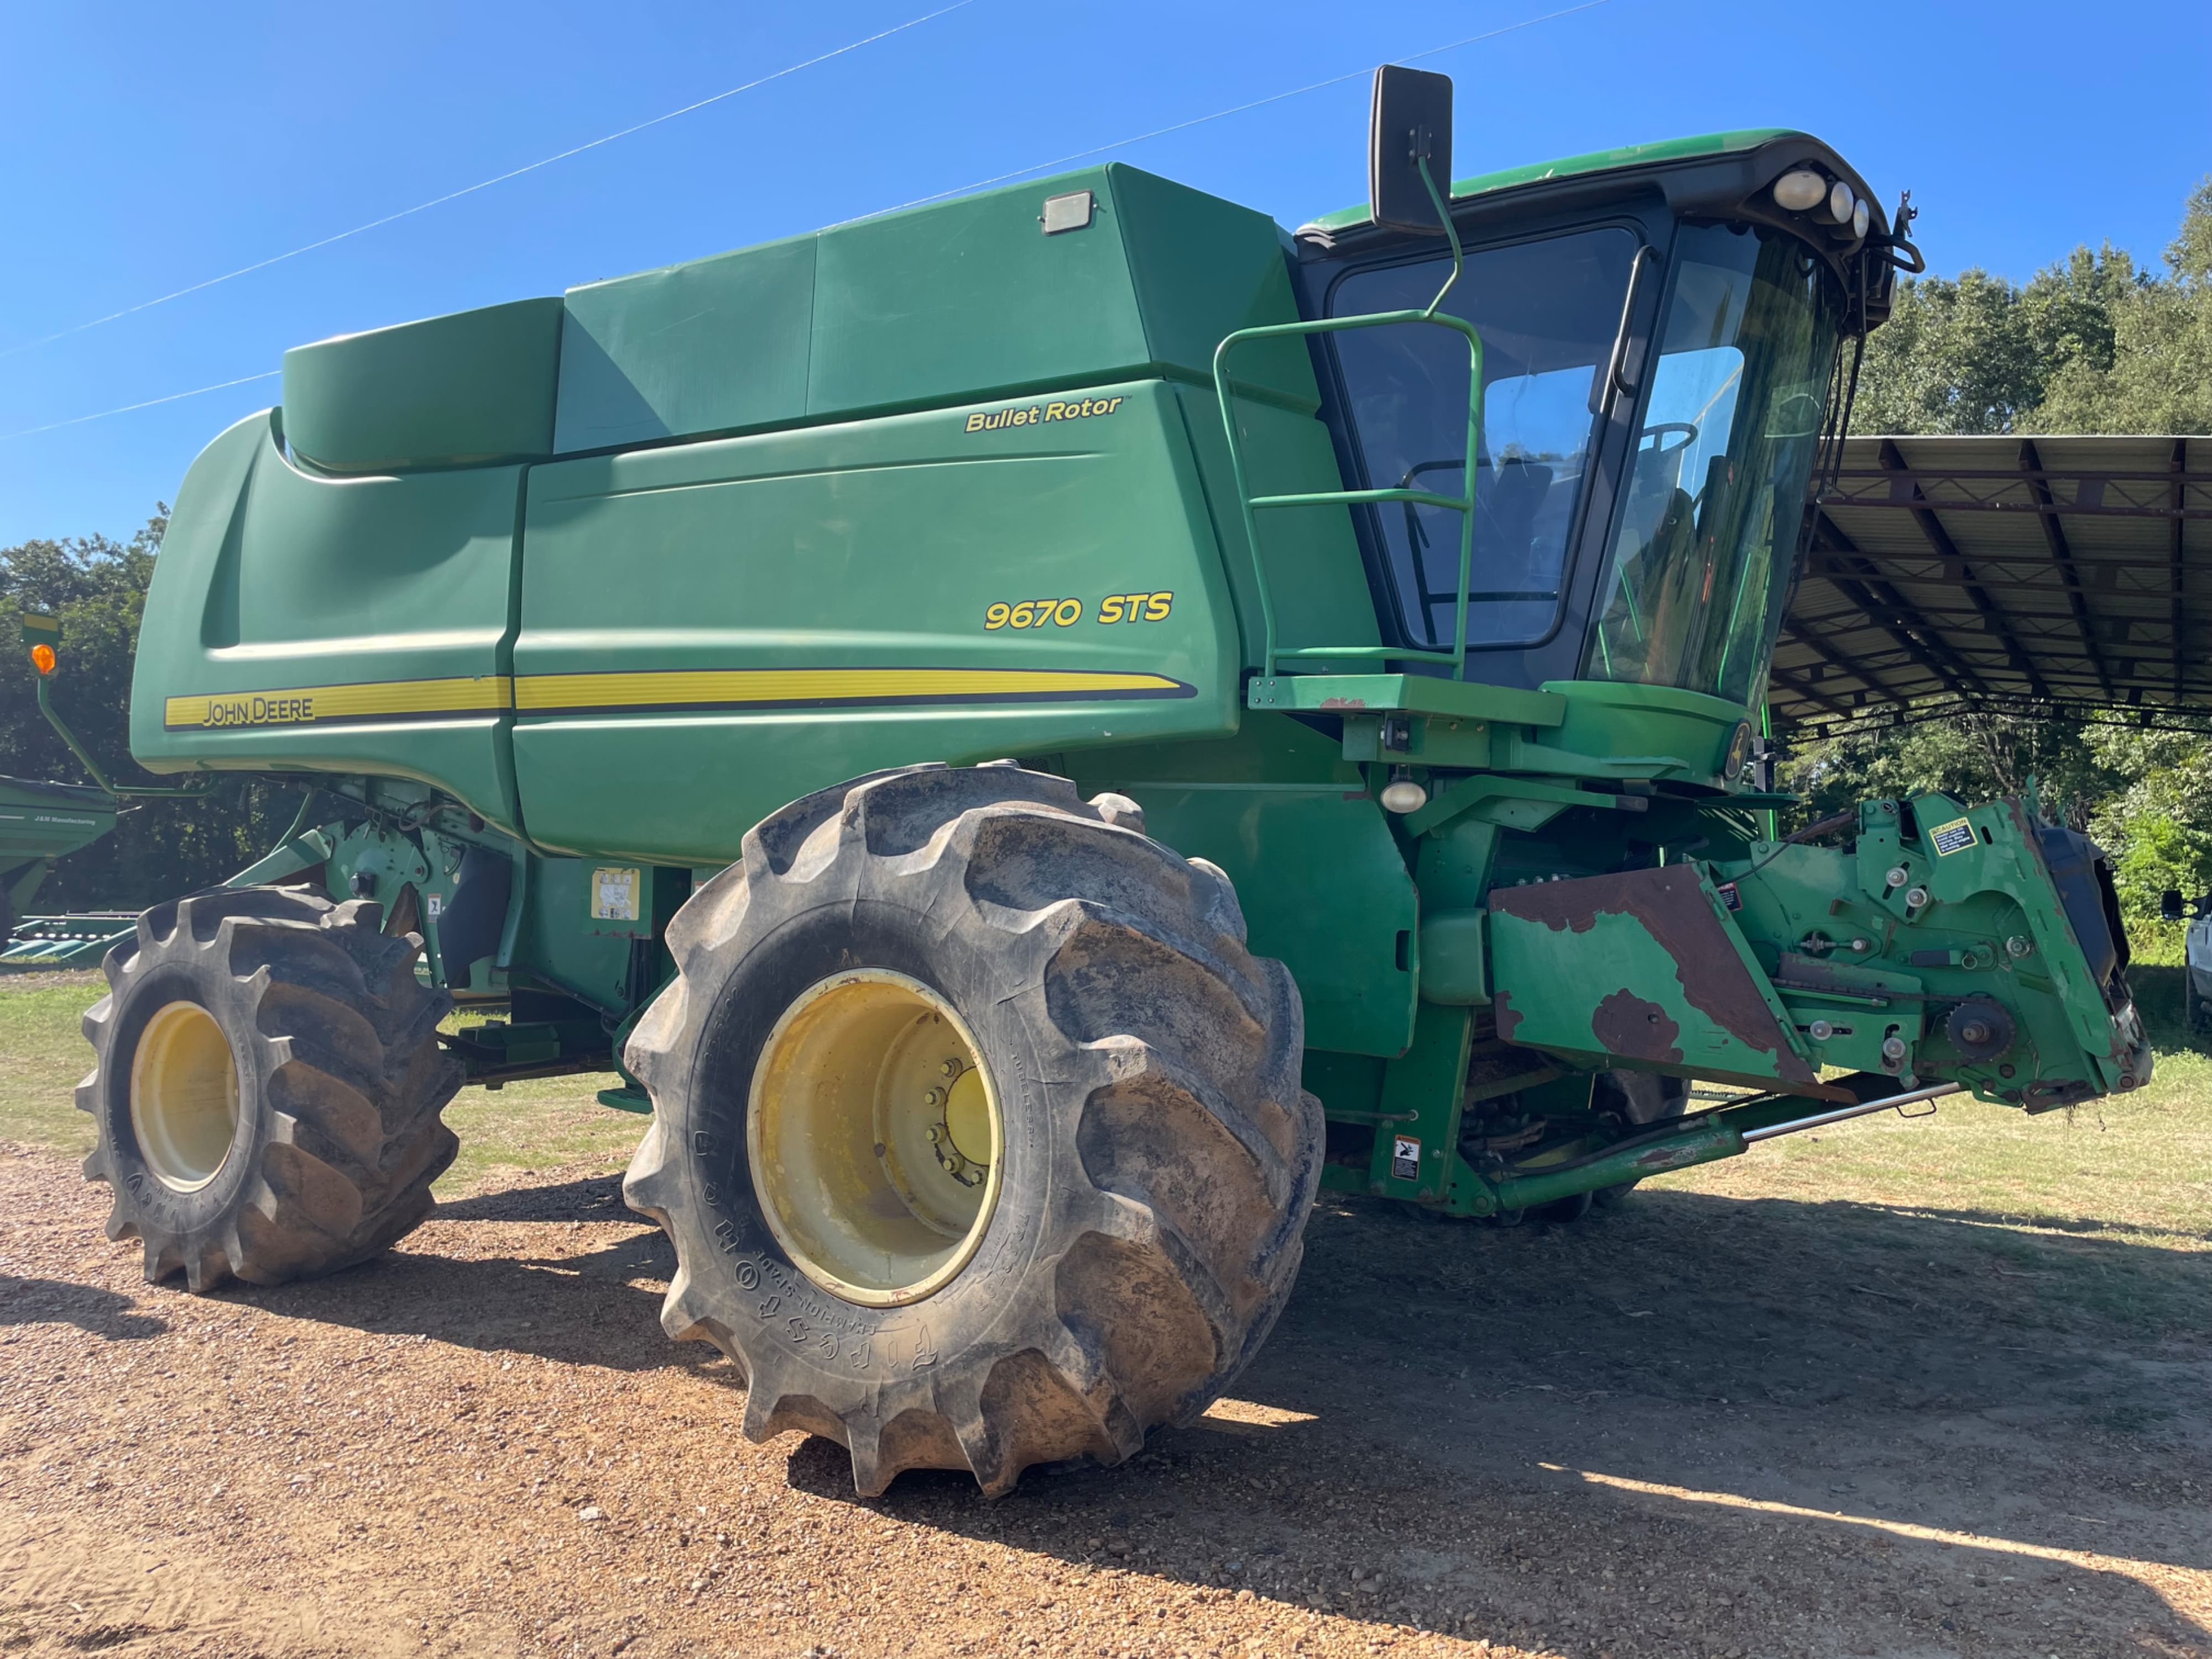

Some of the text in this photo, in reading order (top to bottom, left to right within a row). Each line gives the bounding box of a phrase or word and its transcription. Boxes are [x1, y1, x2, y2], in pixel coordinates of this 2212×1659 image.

[964, 405, 1041, 433] Bullet
[1043, 396, 1124, 423] Rotor
[984, 591, 1173, 630] 9670 STS
[204, 697, 313, 723] JOHN DEERE
[51, 817, 96, 826] Manufacturing
[1937, 819, 1966, 832] CAUTION
